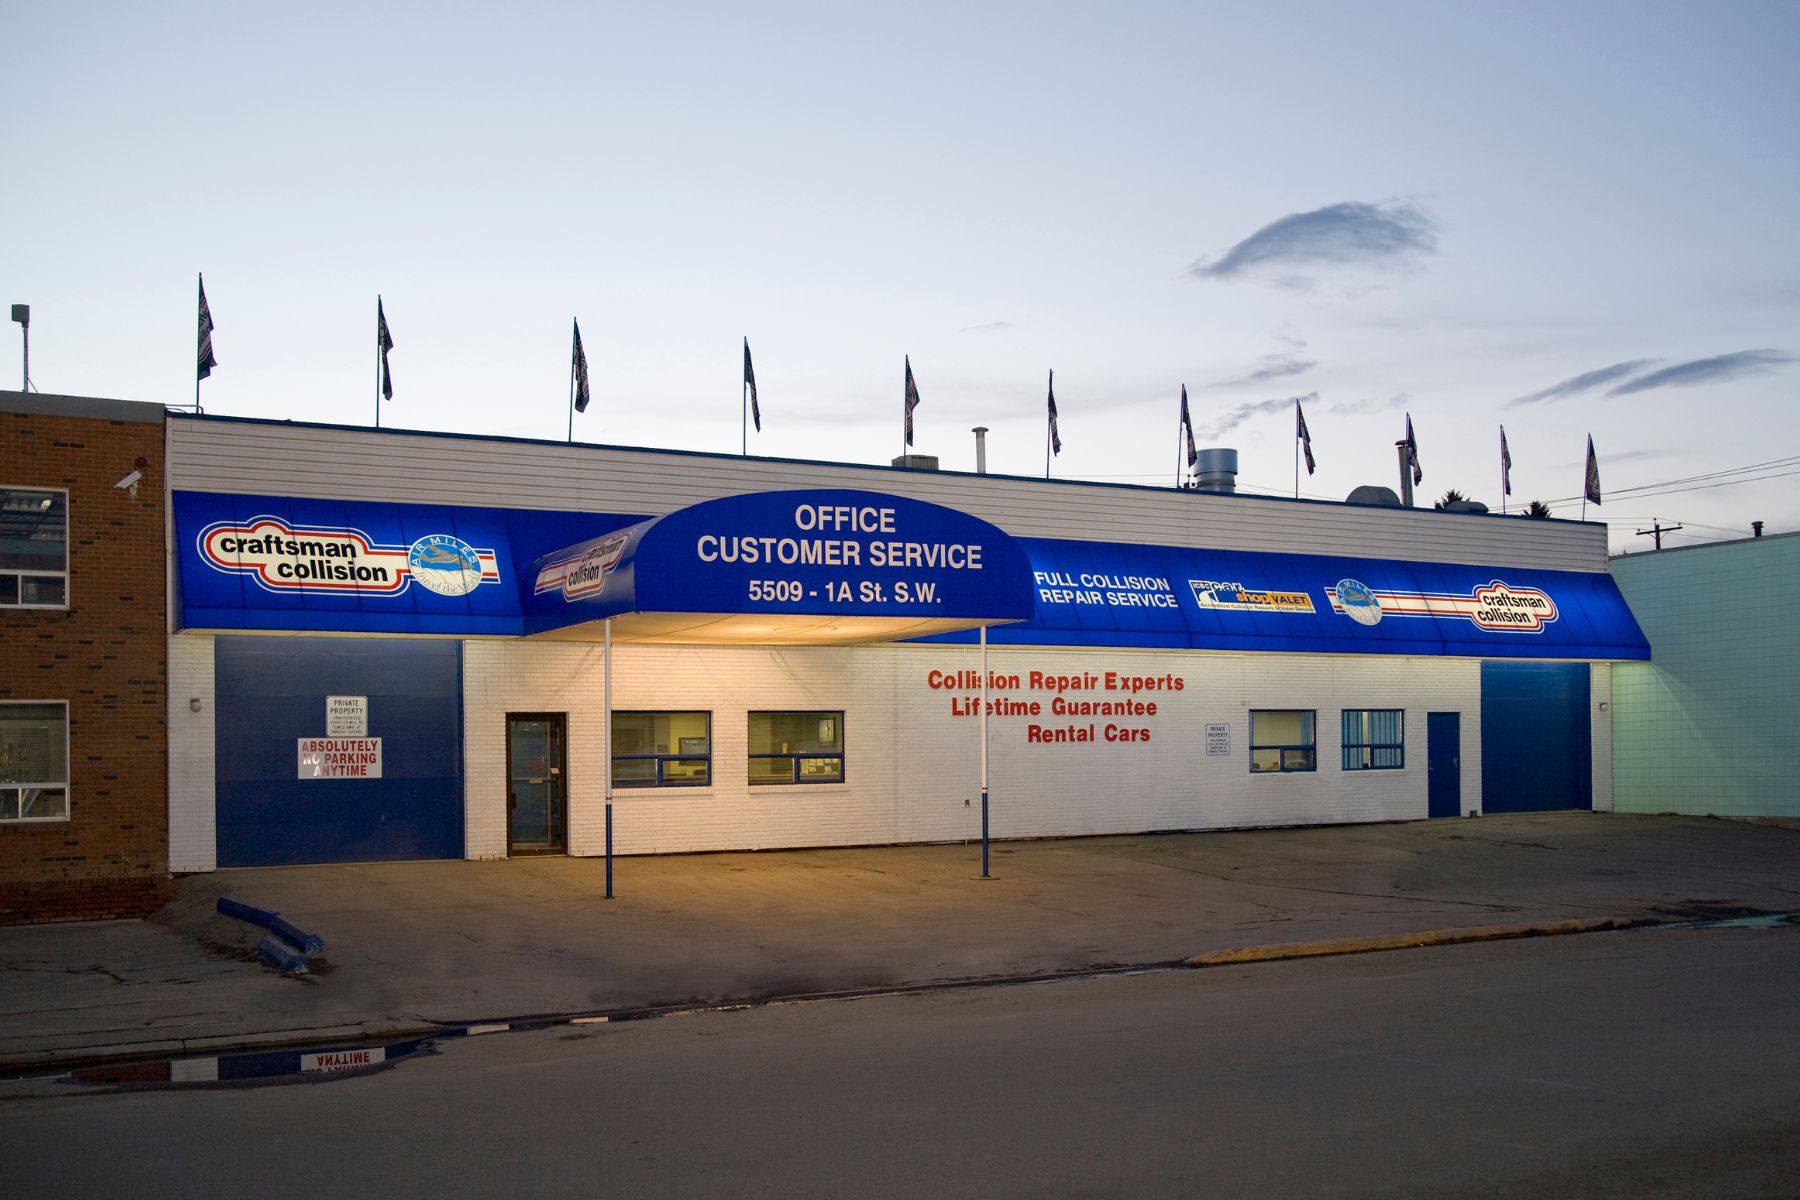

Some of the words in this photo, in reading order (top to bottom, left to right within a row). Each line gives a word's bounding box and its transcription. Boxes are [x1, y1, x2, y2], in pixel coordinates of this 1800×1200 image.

[795, 504, 896, 533] OFFICE
[220, 534, 357, 558] craftsman
[411, 543, 428, 566] AIR
[430, 536, 478, 563] MILES
[697, 535, 861, 566] CUSTOMER
[869, 541, 983, 570] SERVICE
[277, 560, 388, 582] collision
[568, 562, 600, 587] collision
[1033, 571, 1078, 587] FULL
[1080, 573, 1171, 591] COLLISION
[748, 580, 803, 601] 5509
[825, 581, 853, 602] 1A
[859, 581, 887, 602] St.
[894, 582, 942, 603] S.W.
[1039, 588, 1105, 605] REPAIR
[1106, 591, 1179, 608] SERVICE
[1236, 589, 1271, 604] shop
[1270, 595, 1306, 605] VALET
[1483, 593, 1546, 608] craftsman
[1477, 608, 1531, 623] collision
[928, 670, 1020, 690] Collision
[1029, 671, 1098, 693] Repair
[1104, 672, 1184, 693] Experts
[330, 707, 363, 715] PROPERTY
[952, 697, 1041, 716] Lifetime
[1052, 697, 1157, 716] Guarantee
[1028, 725, 1094, 743] Rental
[1104, 724, 1150, 742] Cars
[301, 741, 378, 752] ABSOLUTELY
[303, 753, 320, 765] NO
[324, 753, 377, 764] PARKING
[313, 765, 367, 777] ANYTIME
